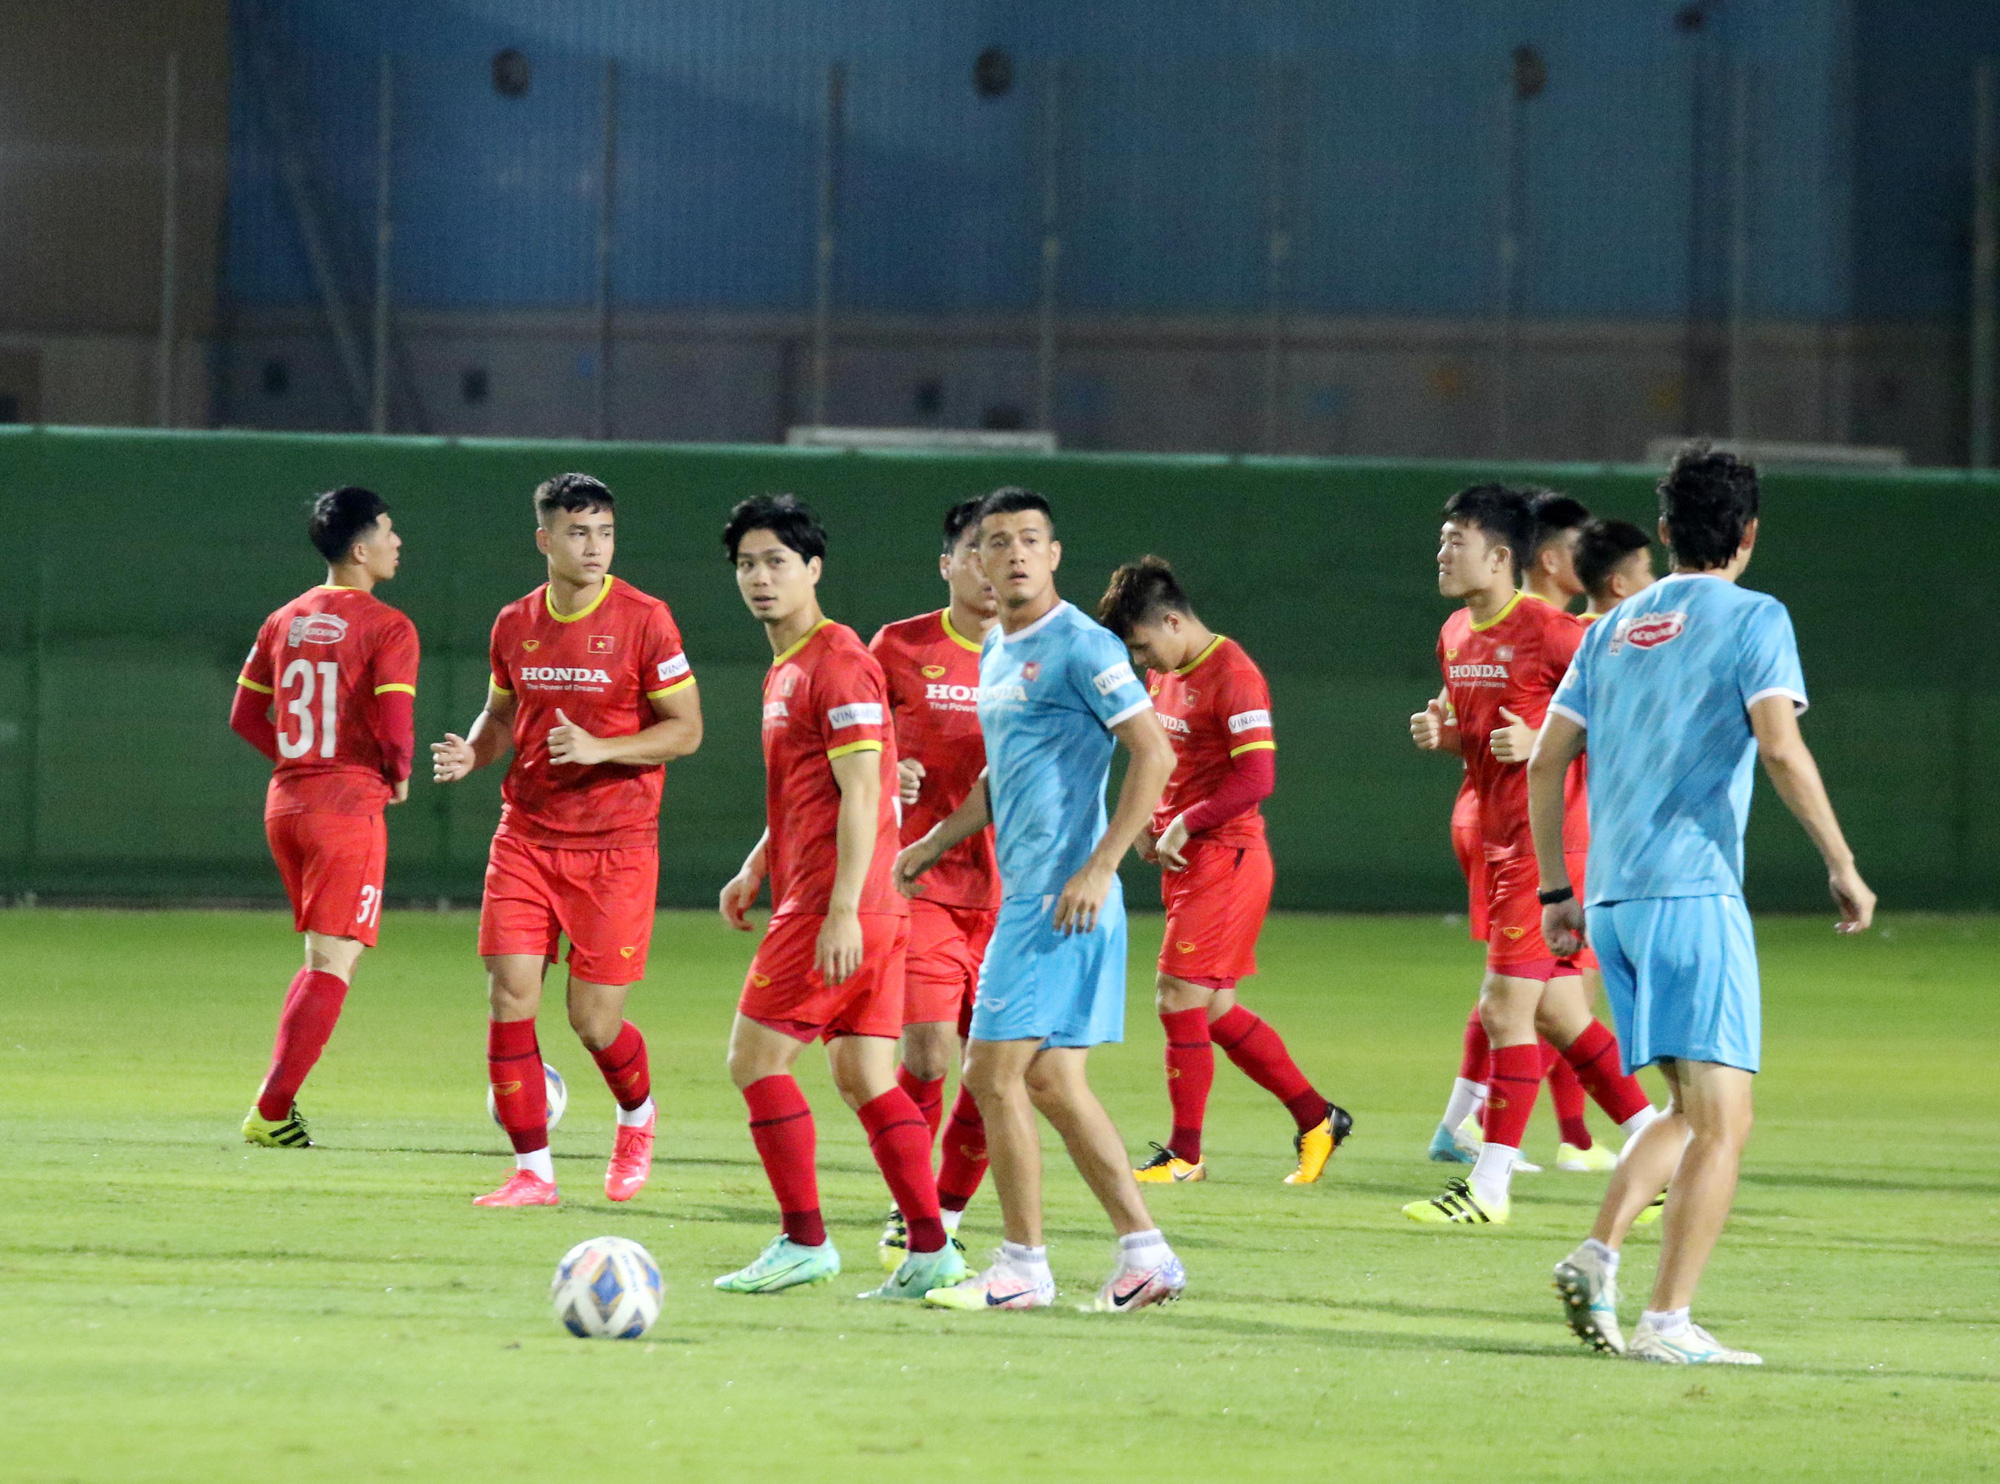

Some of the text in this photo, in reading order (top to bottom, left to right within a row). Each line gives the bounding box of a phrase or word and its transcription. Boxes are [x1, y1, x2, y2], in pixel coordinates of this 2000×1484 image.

[520, 666, 613, 683] HONDA
[1449, 664, 1510, 679] HONDA
[277, 658, 339, 759] 31
[1155, 711, 1191, 734] NDA
[356, 884, 383, 928] 31
